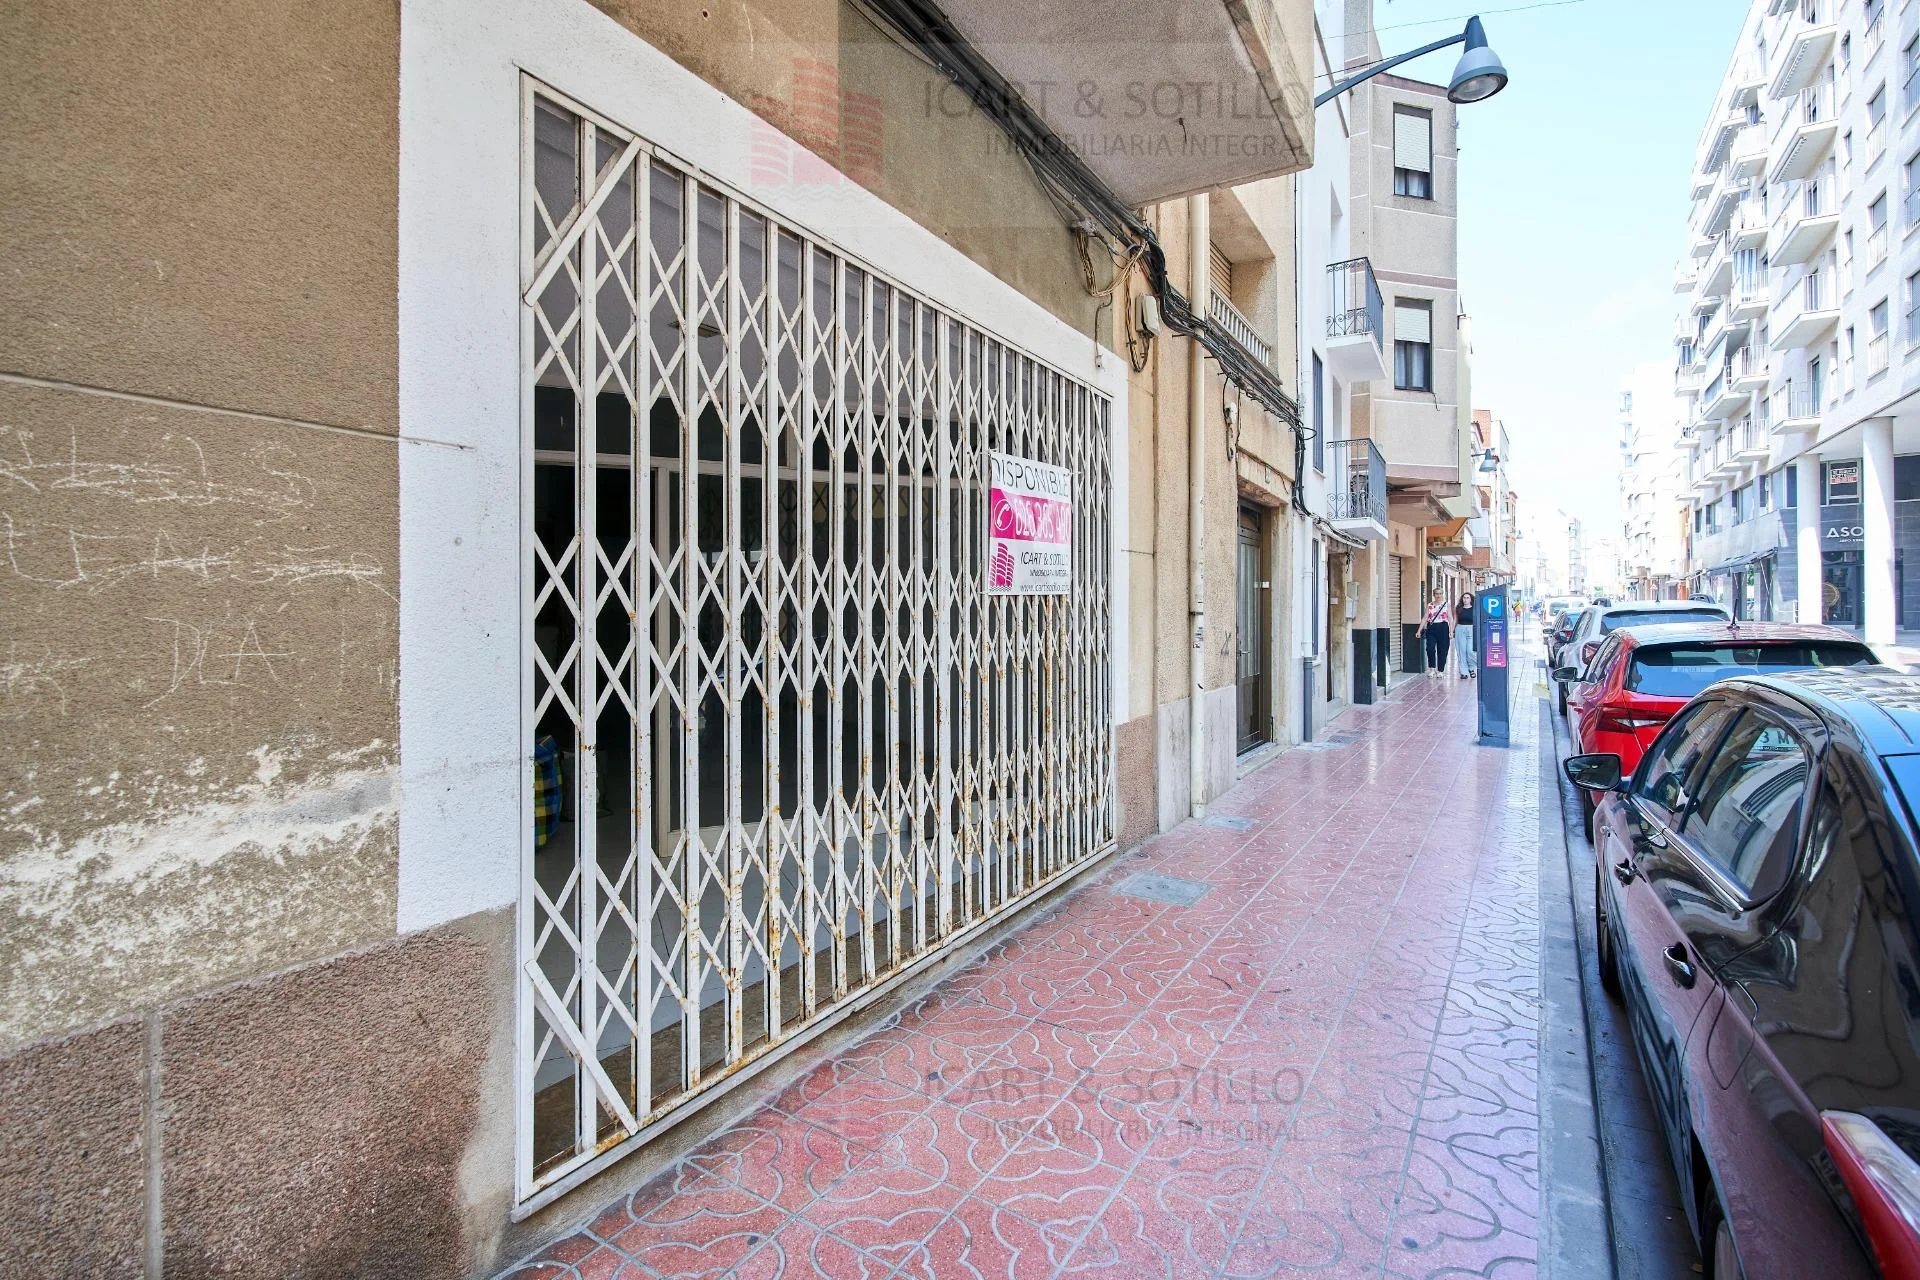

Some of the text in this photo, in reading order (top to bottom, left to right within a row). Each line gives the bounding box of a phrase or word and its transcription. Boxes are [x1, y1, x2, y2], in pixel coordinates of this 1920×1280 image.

[991, 457, 1069, 496] DISPONIBLE
[1020, 551, 1042, 565] ICART
[1488, 599, 1500, 614] P
